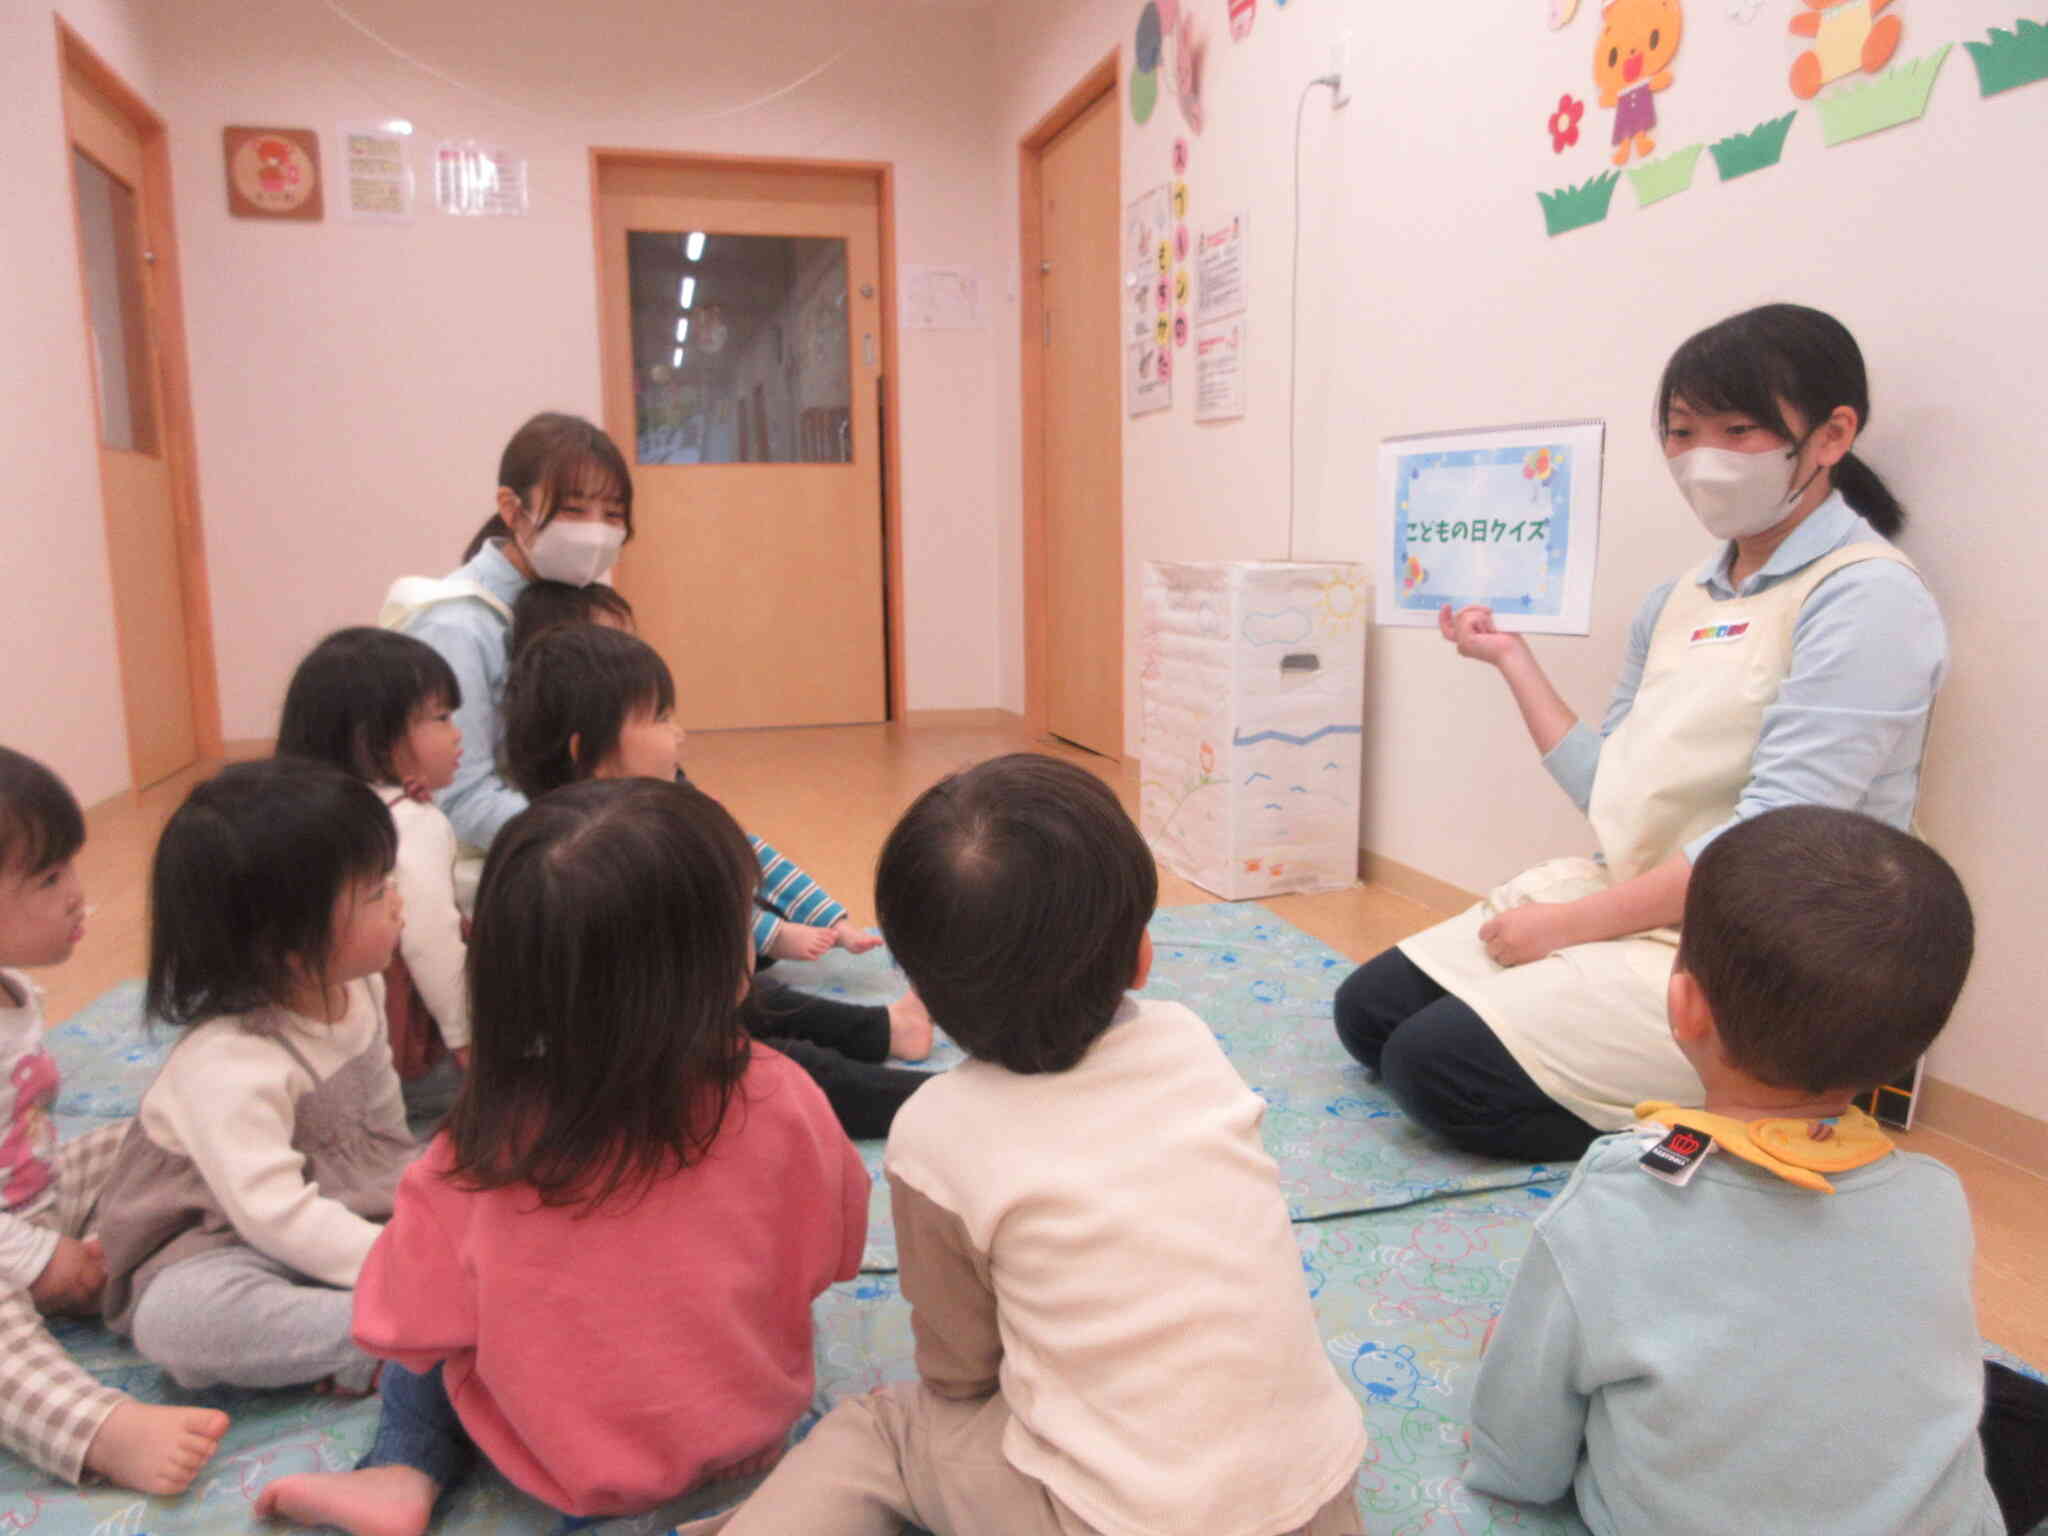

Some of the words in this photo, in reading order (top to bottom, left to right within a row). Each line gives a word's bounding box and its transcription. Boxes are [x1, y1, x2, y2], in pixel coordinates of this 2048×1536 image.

[1407, 518, 1548, 543] こどもの日クイズ
